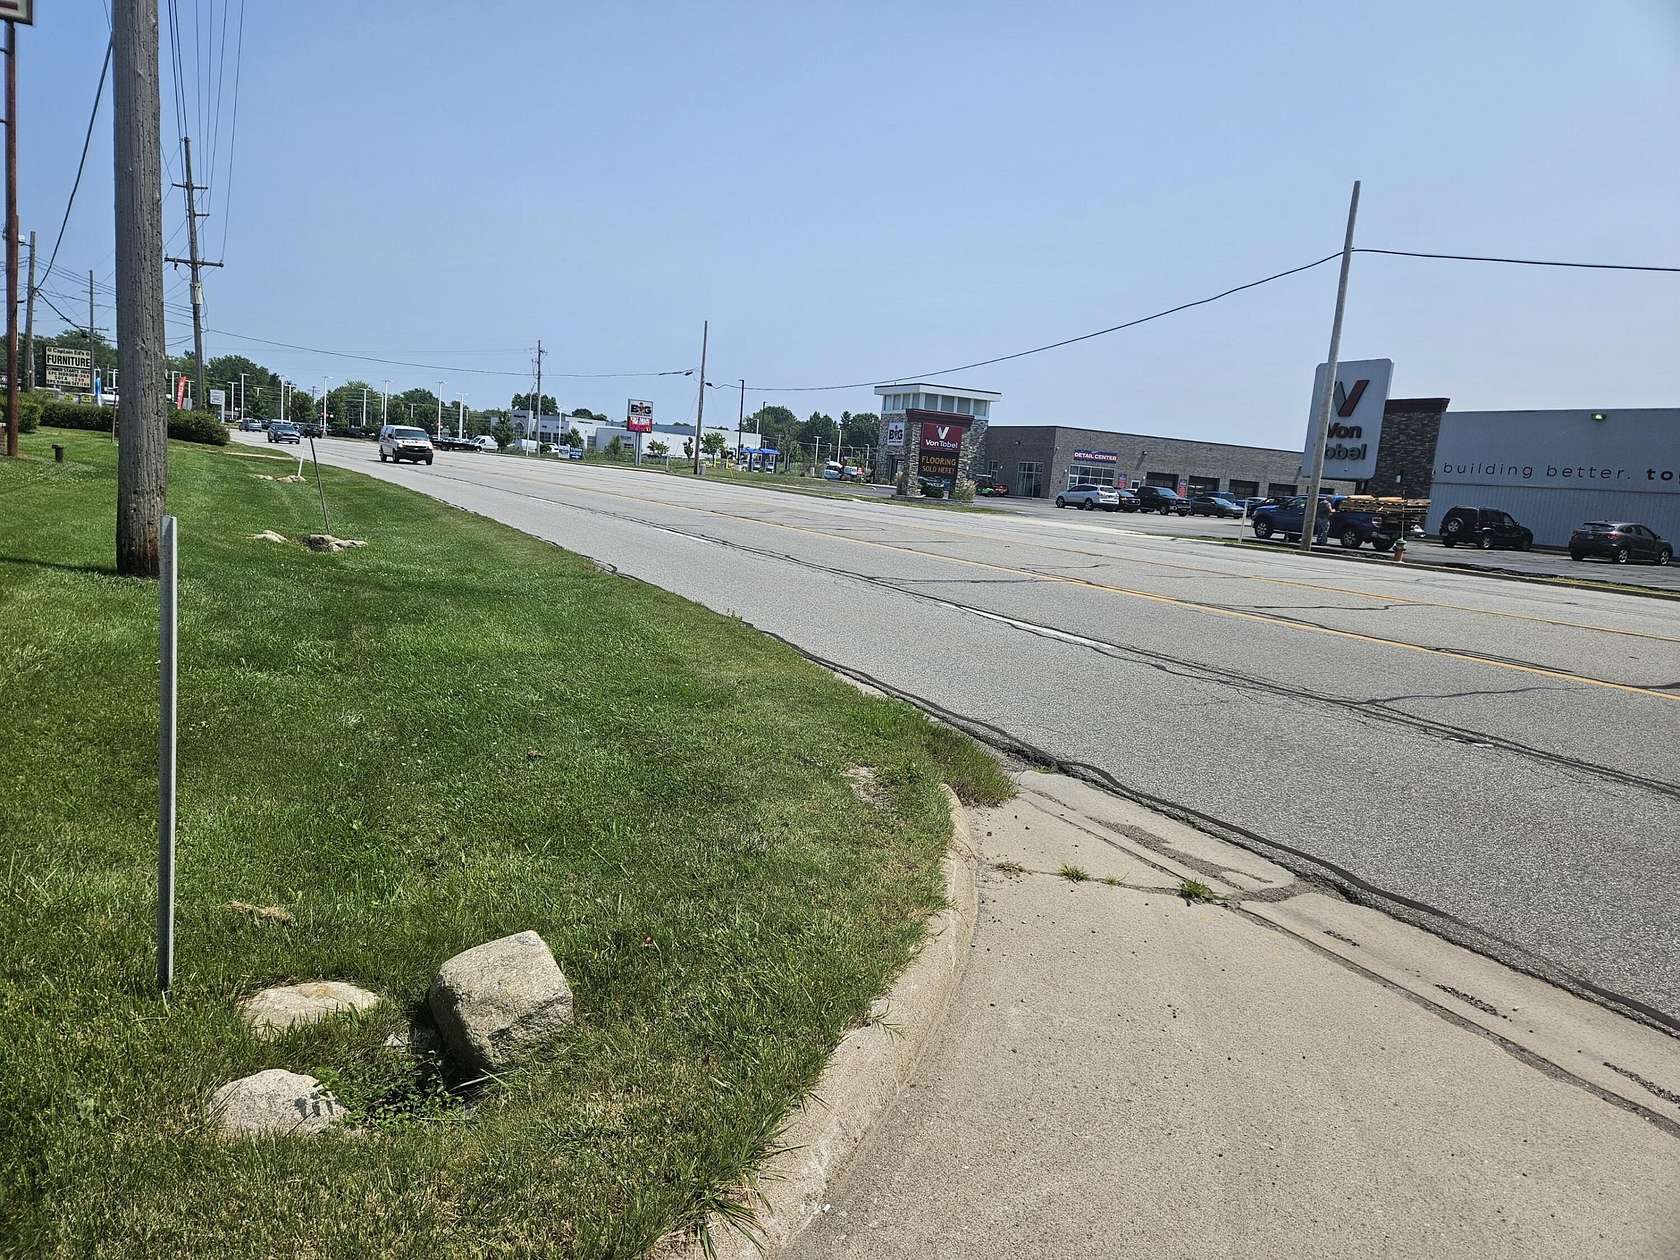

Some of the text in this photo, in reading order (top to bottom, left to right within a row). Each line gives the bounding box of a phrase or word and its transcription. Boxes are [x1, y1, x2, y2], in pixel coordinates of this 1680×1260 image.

[47, 354, 90, 367] FURNITURE
[925, 439, 958, 449] Von Tobel
[1324, 443, 1367, 460] obel
[921, 455, 957, 466] FLOORING
[1443, 462, 1533, 479] building
[1546, 464, 1631, 480] better.
